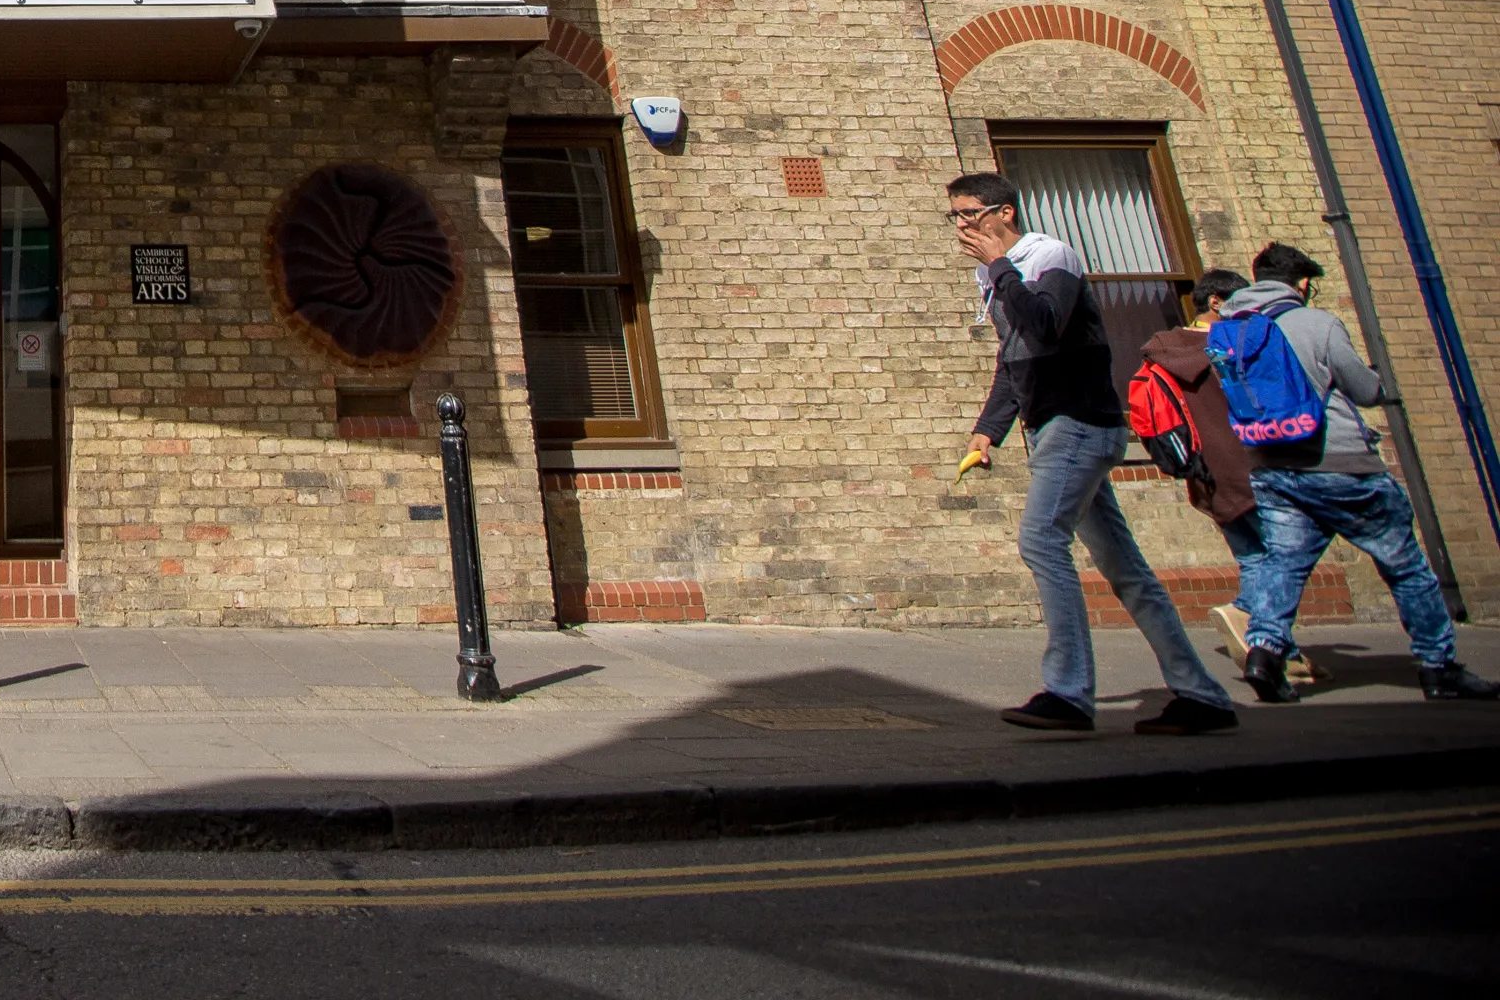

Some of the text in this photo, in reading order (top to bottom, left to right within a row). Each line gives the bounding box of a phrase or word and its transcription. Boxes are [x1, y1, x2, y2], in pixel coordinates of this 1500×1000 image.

[135, 248, 184, 257] CAMBRIDGE
[135, 257, 184, 265] SCHOOL OF
[136, 264, 185, 275] VISUAL &
[136, 283, 187, 300] ARTS
